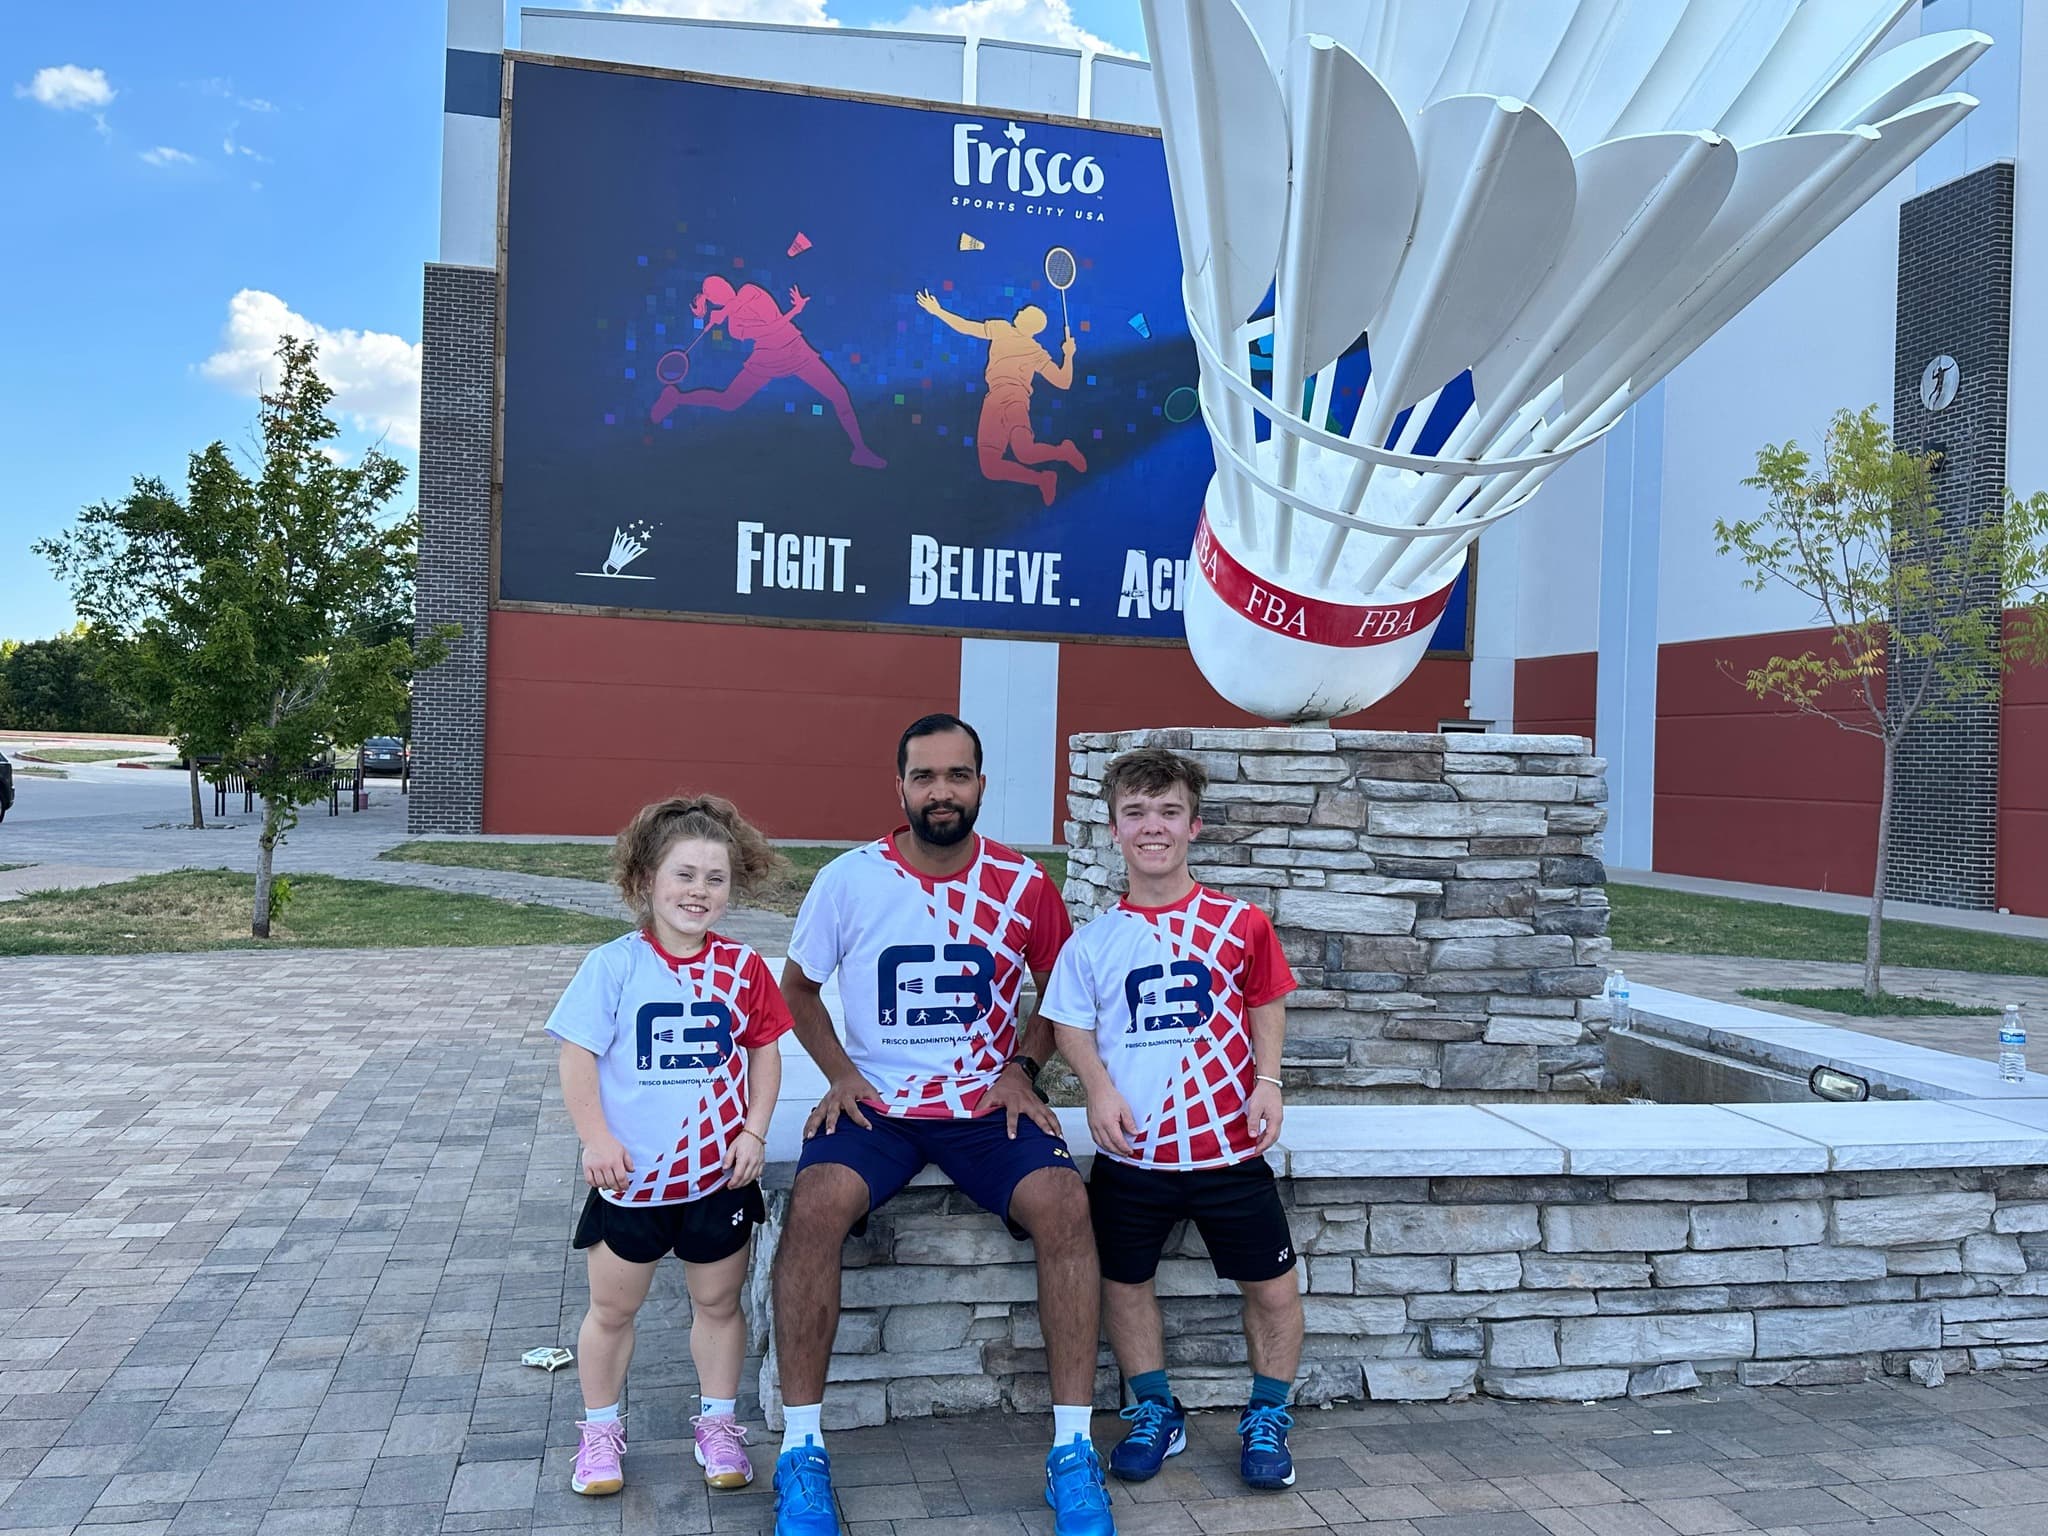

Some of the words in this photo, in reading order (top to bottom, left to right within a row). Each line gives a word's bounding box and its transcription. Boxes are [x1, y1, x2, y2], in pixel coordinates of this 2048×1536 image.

[954, 121, 1105, 197] Frisco
[951, 196, 1016, 212] SPORTS
[1026, 205, 1065, 217] CITY
[1075, 210, 1105, 222] USA
[1244, 583, 1308, 637] FBA
[1353, 607, 1418, 638] FBA
[881, 1038, 909, 1046] FRISCO
[910, 1035, 956, 1046] BADMINTON
[956, 1032, 990, 1043] ACADY
[1182, 1036, 1213, 1044] ACADY
[701, 1076, 730, 1084] ACAY
